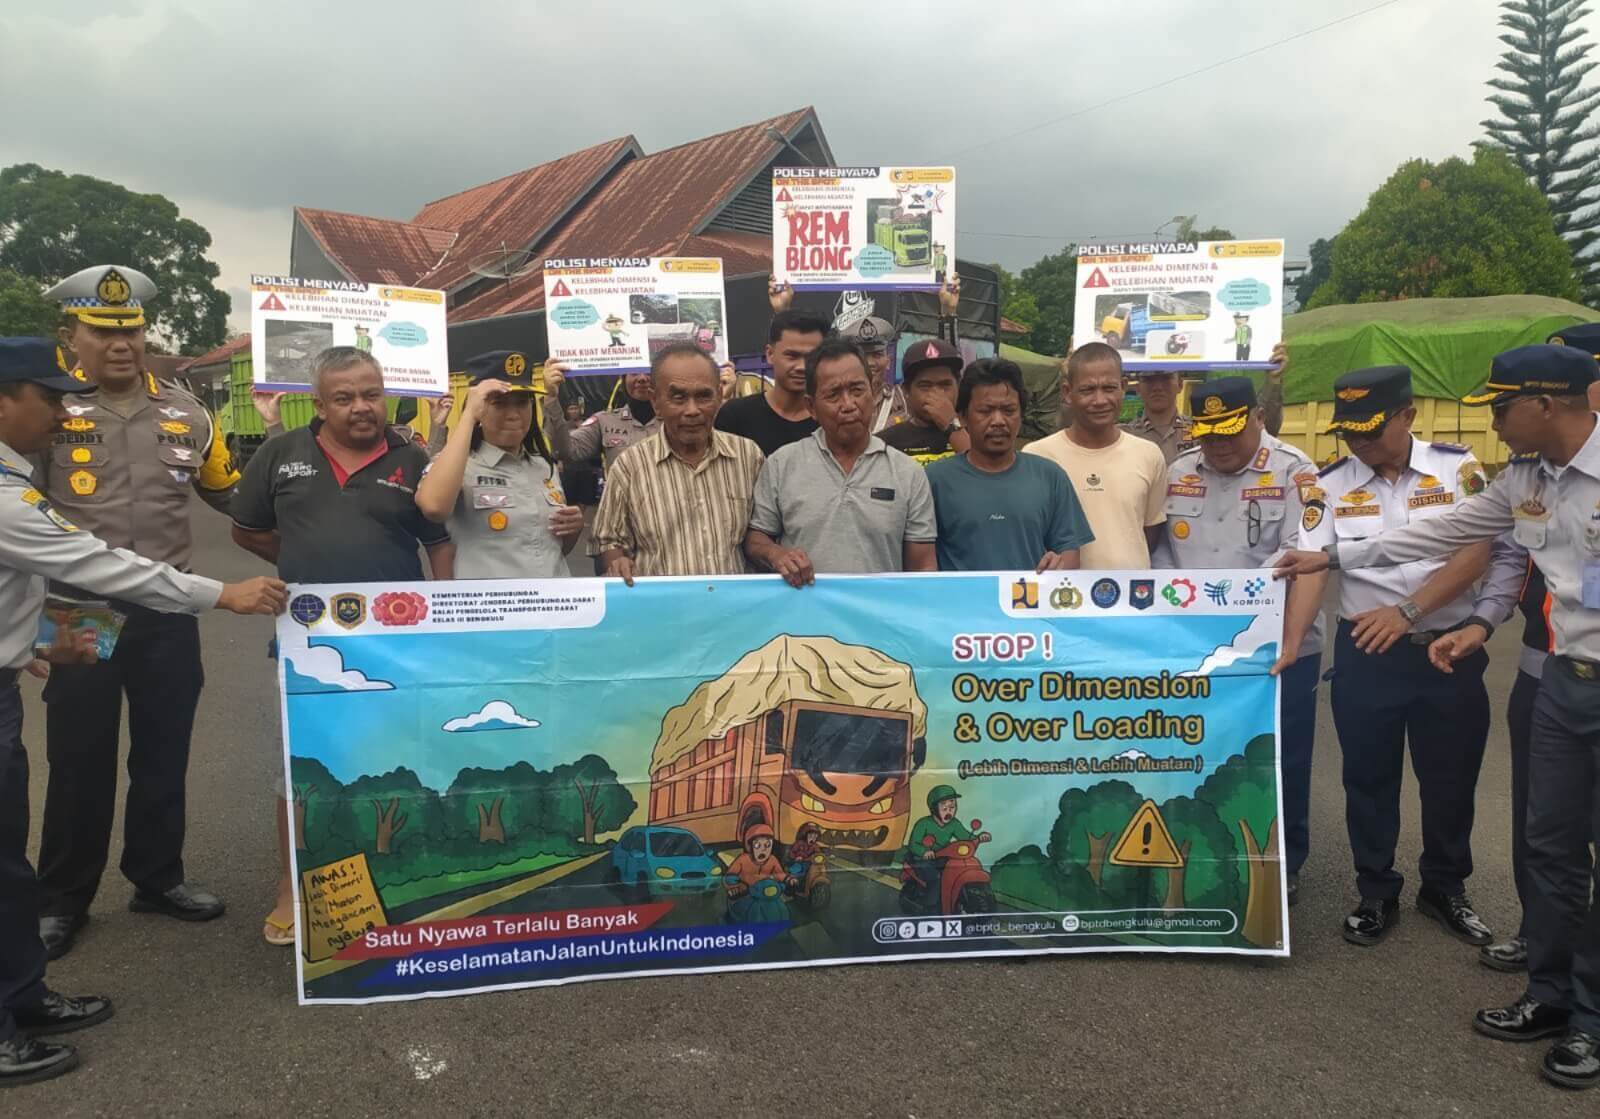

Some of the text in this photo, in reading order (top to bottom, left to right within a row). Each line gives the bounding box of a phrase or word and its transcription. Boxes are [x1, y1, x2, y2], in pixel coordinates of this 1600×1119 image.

[773, 168, 877, 177] POLISI MENYAPA
[787, 211, 850, 246] REM
[1079, 242, 1196, 256] POLISI MENYAPA
[544, 257, 648, 269] POLISI MENYAPA
[785, 247, 851, 271] BLONG
[1108, 264, 1163, 273] KELEBIHAN
[1166, 262, 1208, 271] DIMENSI
[253, 275, 300, 287] POLISI
[303, 278, 367, 293] MENYAPA
[1111, 275, 1214, 286] KELEBIHAN MUATAN
[576, 286, 655, 295] KELEBIHAN MUATAN
[285, 293, 338, 304] KELEBIHAN
[289, 304, 387, 318] KELEBIHAN MUATAN
[1233, 598, 1275, 606] KOMDIGI
[953, 634, 1035, 662] STOP
[952, 670, 1210, 702] Over Dimension
[954, 709, 1205, 744] & Over Loading
[958, 759, 1008, 779] (Lebih
[1011, 758, 1073, 774] Dimensi
[1075, 757, 1089, 773] &
[1091, 756, 1134, 773] Lebih
[1137, 756, 1192, 772] Muatan
[365, 909, 639, 949] Satu Nyawa Terlalu Banyak
[1080, 917, 1221, 932] bptdbengkulu@gmail.com
[395, 930, 755, 977] #KeselamatanJalanUntukIndonesia
